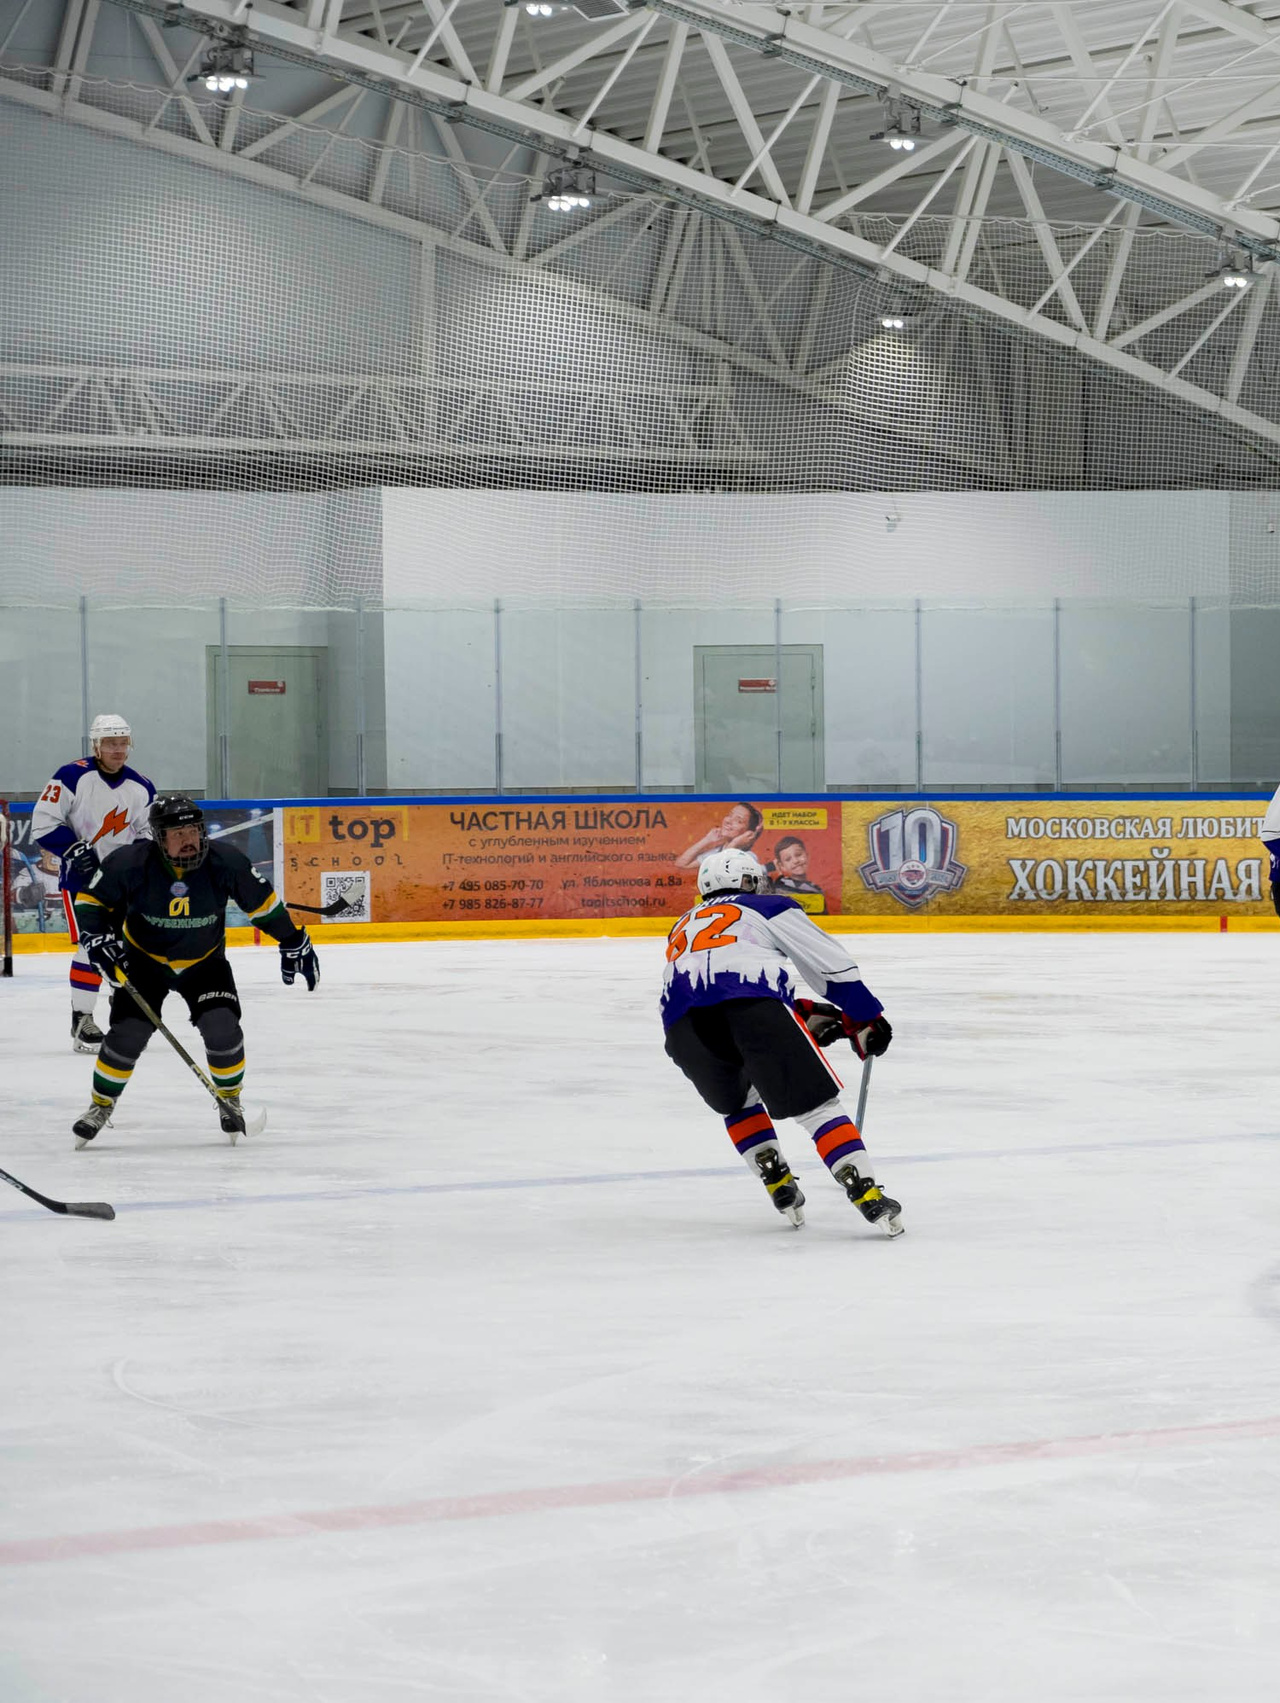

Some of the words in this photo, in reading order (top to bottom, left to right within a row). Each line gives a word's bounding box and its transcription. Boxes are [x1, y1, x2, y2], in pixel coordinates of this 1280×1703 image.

[41, 785, 62, 804] 23
[289, 814, 315, 837] IT
[450, 811, 567, 831] ЧАСТНАЯ
[575, 809, 668, 830] ШКОЛА
[1006, 817, 1172, 839] МОСКОВСКАЯ
[329, 814, 396, 848] top
[880, 809, 941, 871] 10
[481, 835, 569, 850] углубленным
[573, 836, 646, 847] изучением
[550, 851, 633, 865] английского
[638, 852, 677, 861] языка
[583, 875, 651, 887] Яблочкова
[1007, 847, 1262, 901] ХОККЕЙНАЯ
[459, 879, 481, 891] 495
[484, 880, 544, 891] 085-70-70
[459, 899, 481, 910] 985
[485, 898, 544, 910] 826-87-77
